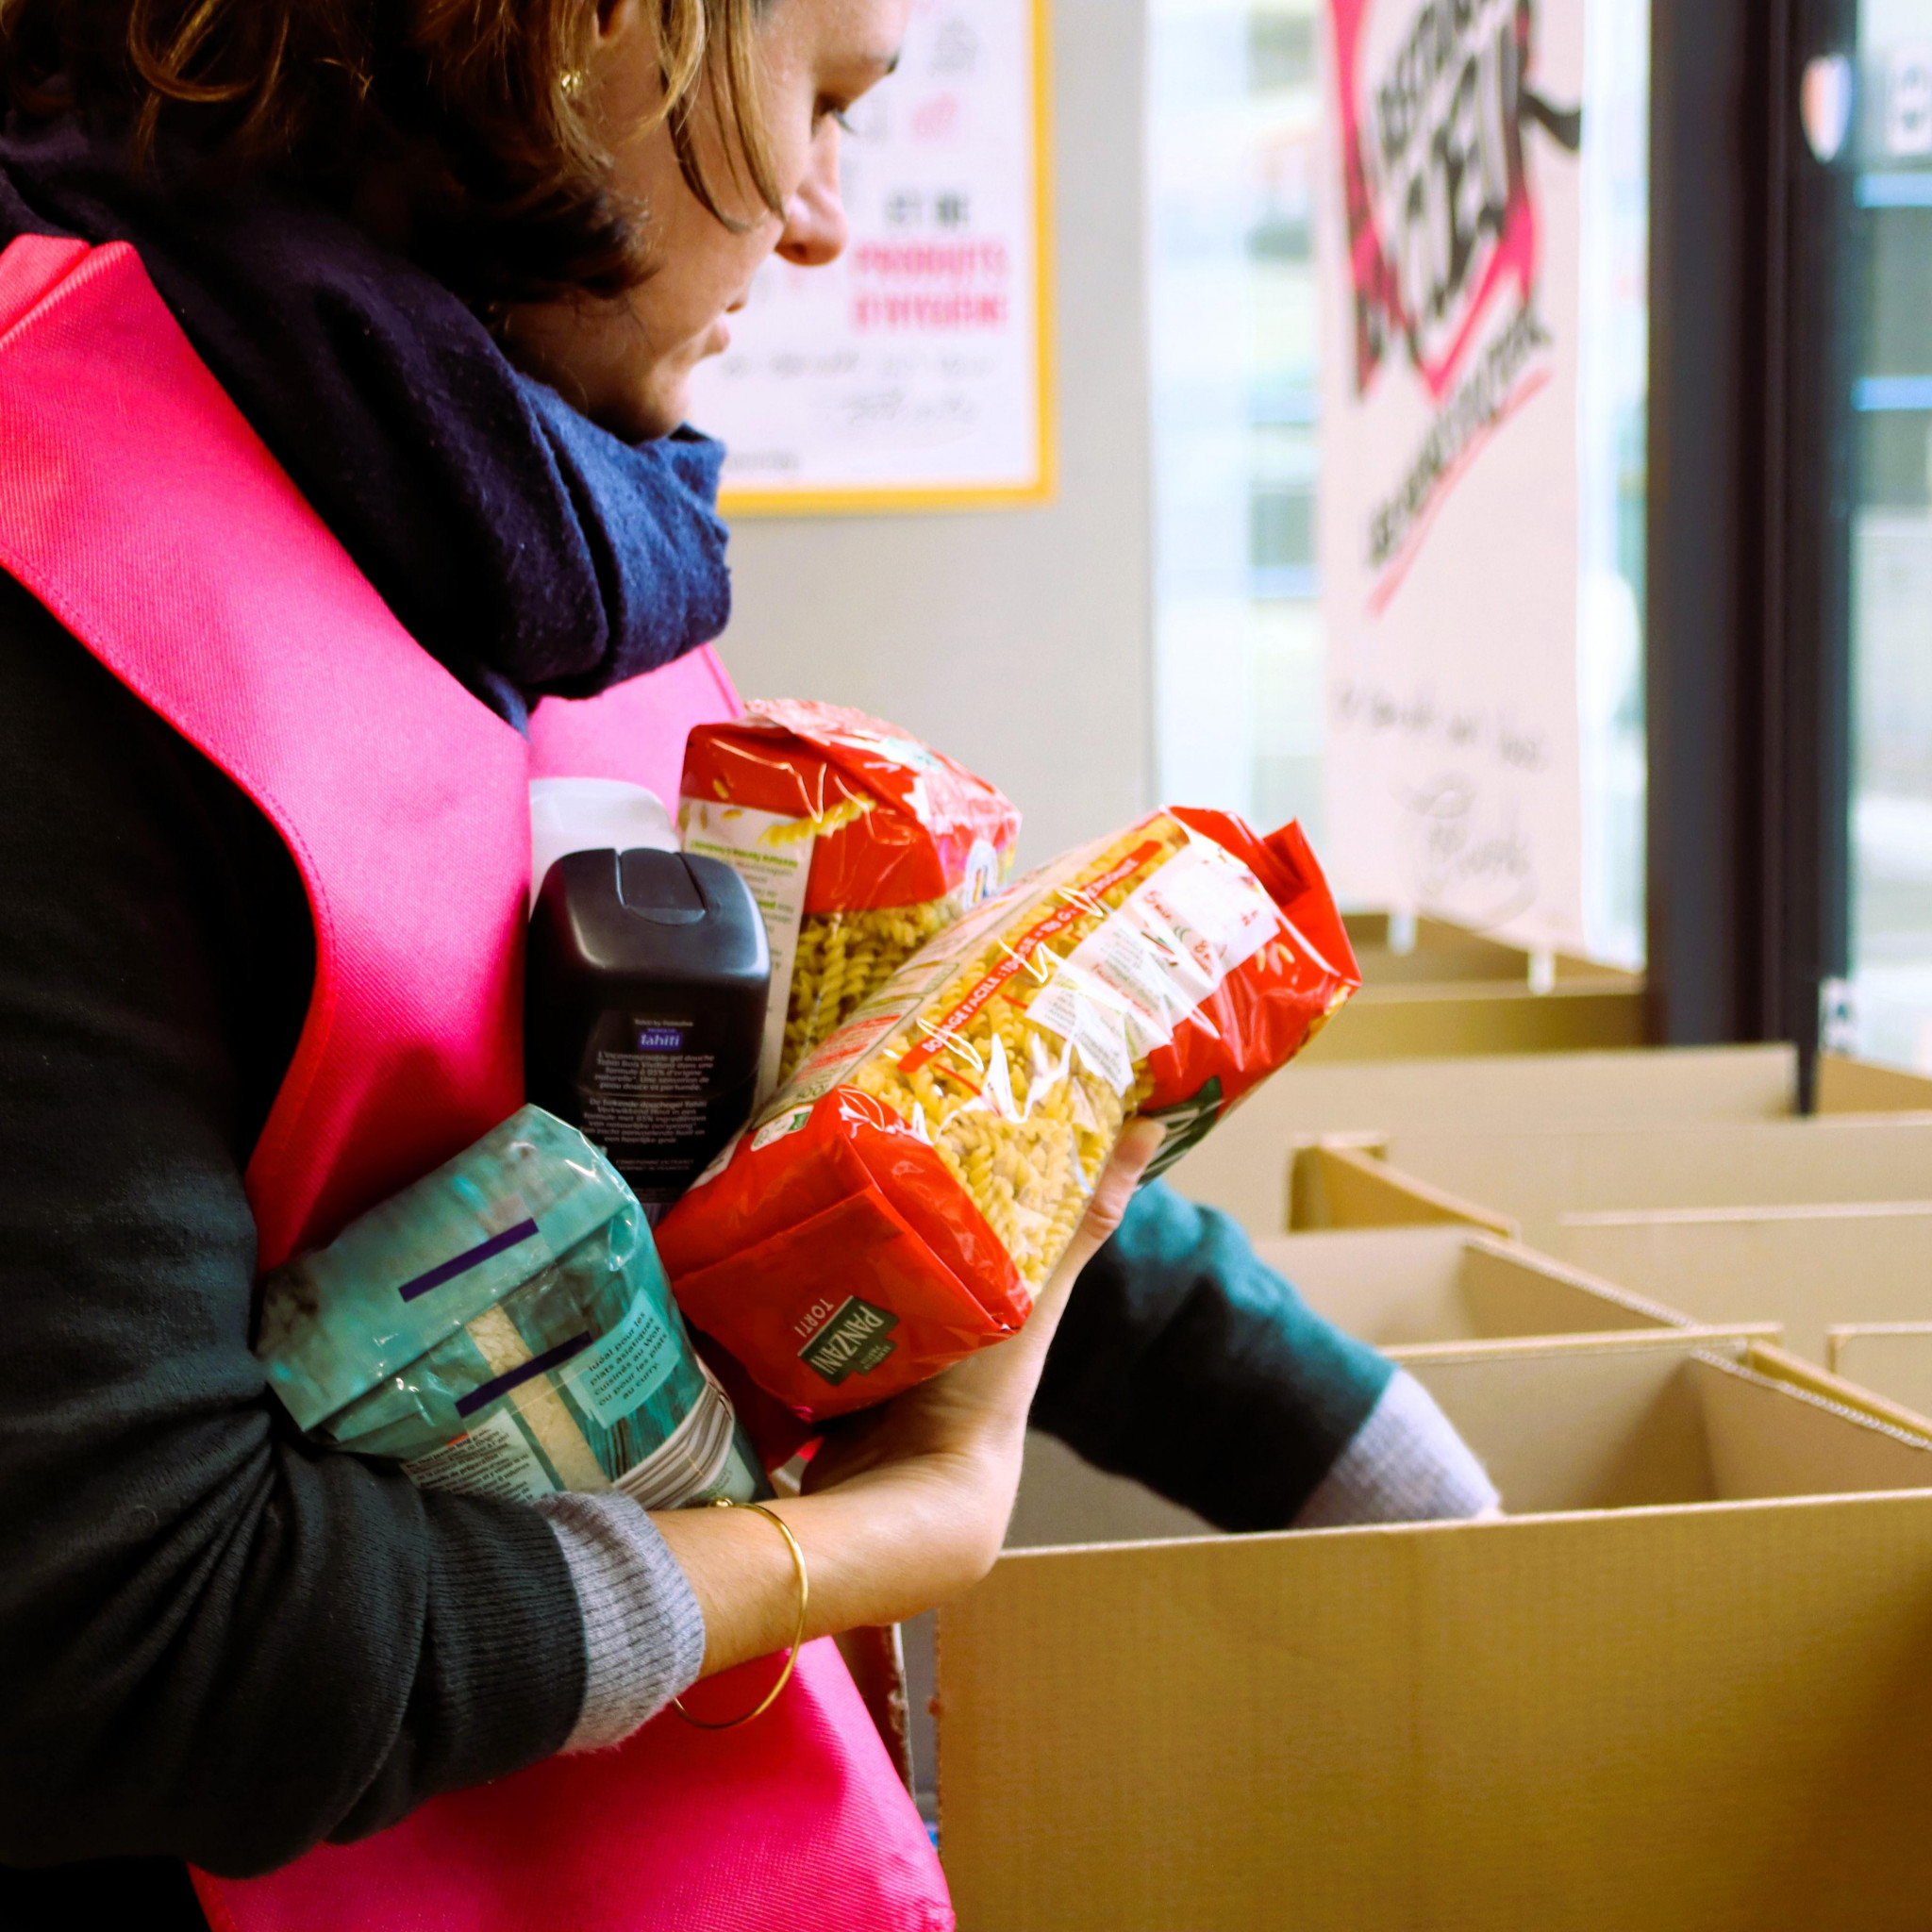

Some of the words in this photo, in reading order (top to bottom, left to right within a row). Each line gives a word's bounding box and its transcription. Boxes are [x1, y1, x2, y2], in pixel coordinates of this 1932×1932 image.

[962, 975, 1000, 1013] FACILE
[641, 1033, 679, 1046] tahiti
[615, 1329, 635, 1350] pour
[634, 1312, 645, 1326] les
[793, 1299, 834, 1338] TORTI
[590, 1364, 614, 1386] plats
[616, 1318, 654, 1363] asiatiques
[633, 1349, 643, 1361] au
[644, 1326, 660, 1346] Wok
[809, 1306, 885, 1374] PANZANI
[599, 1394, 612, 1406] ou
[614, 1373, 635, 1395] pour
[636, 1358, 648, 1372] les
[649, 1334, 667, 1358] plats
[623, 1387, 634, 1399] au
